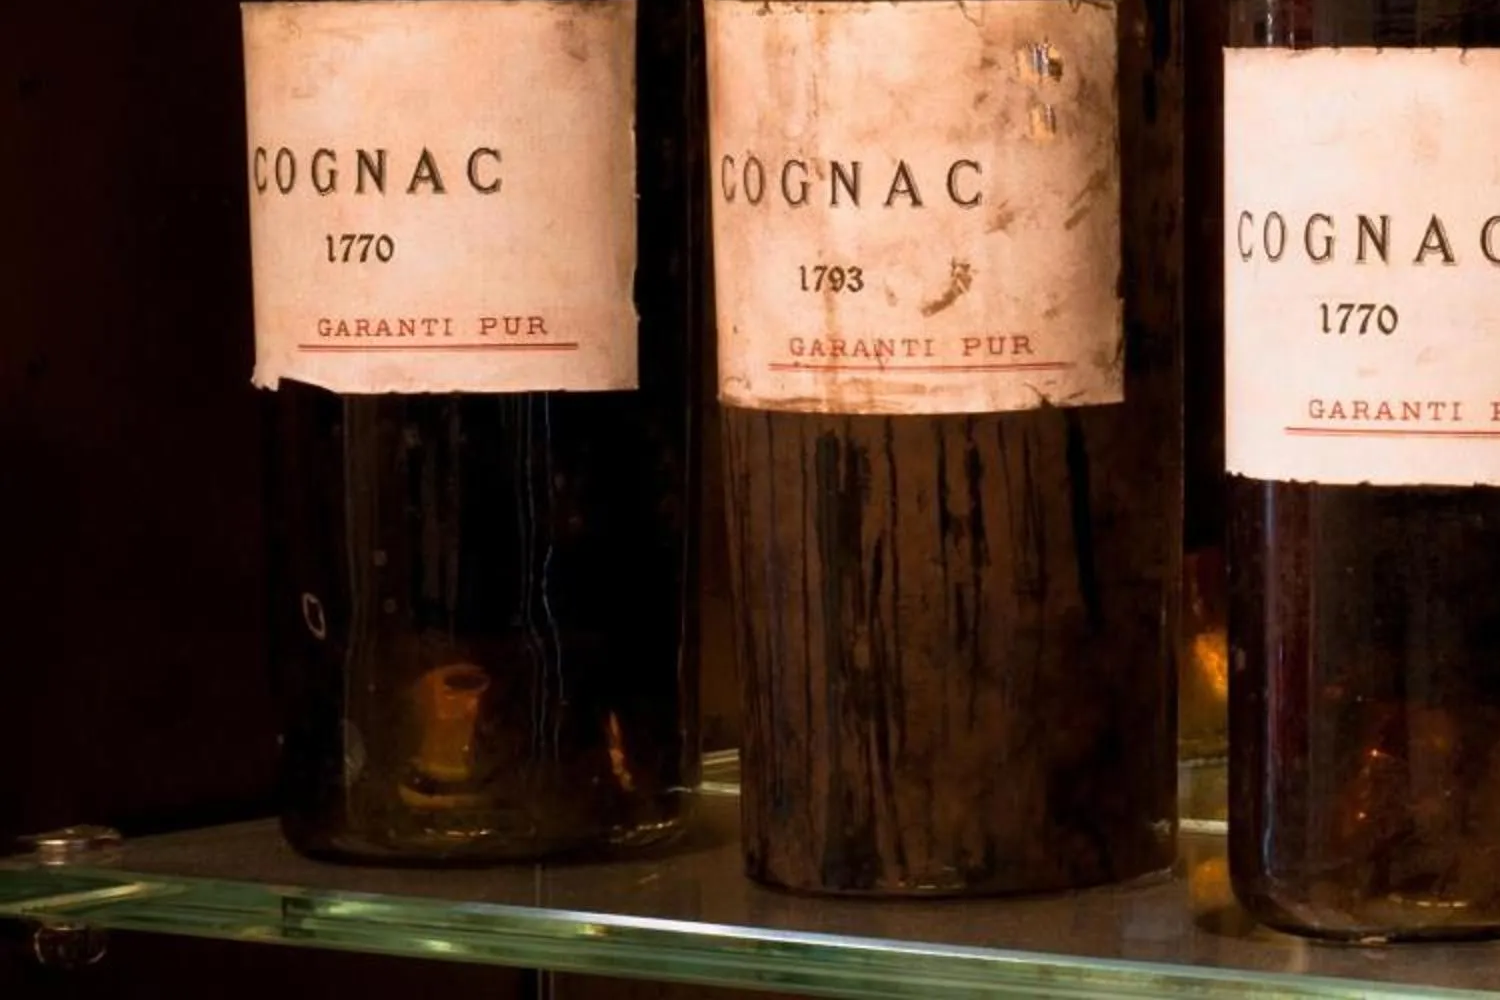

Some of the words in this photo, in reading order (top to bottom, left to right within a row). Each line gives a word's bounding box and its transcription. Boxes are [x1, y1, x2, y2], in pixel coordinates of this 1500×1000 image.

[253, 145, 503, 196] COGNAC
[720, 154, 983, 208] COGNAC
[326, 234, 394, 263] 1770
[799, 265, 864, 293] 1793
[317, 318, 453, 338] GARANTI
[479, 317, 549, 336] PUR
[1320, 303, 1398, 335] 1770
[789, 337, 935, 358] GARANTI
[961, 336, 1034, 356] PUR
[1308, 399, 1461, 421] GARANTI
